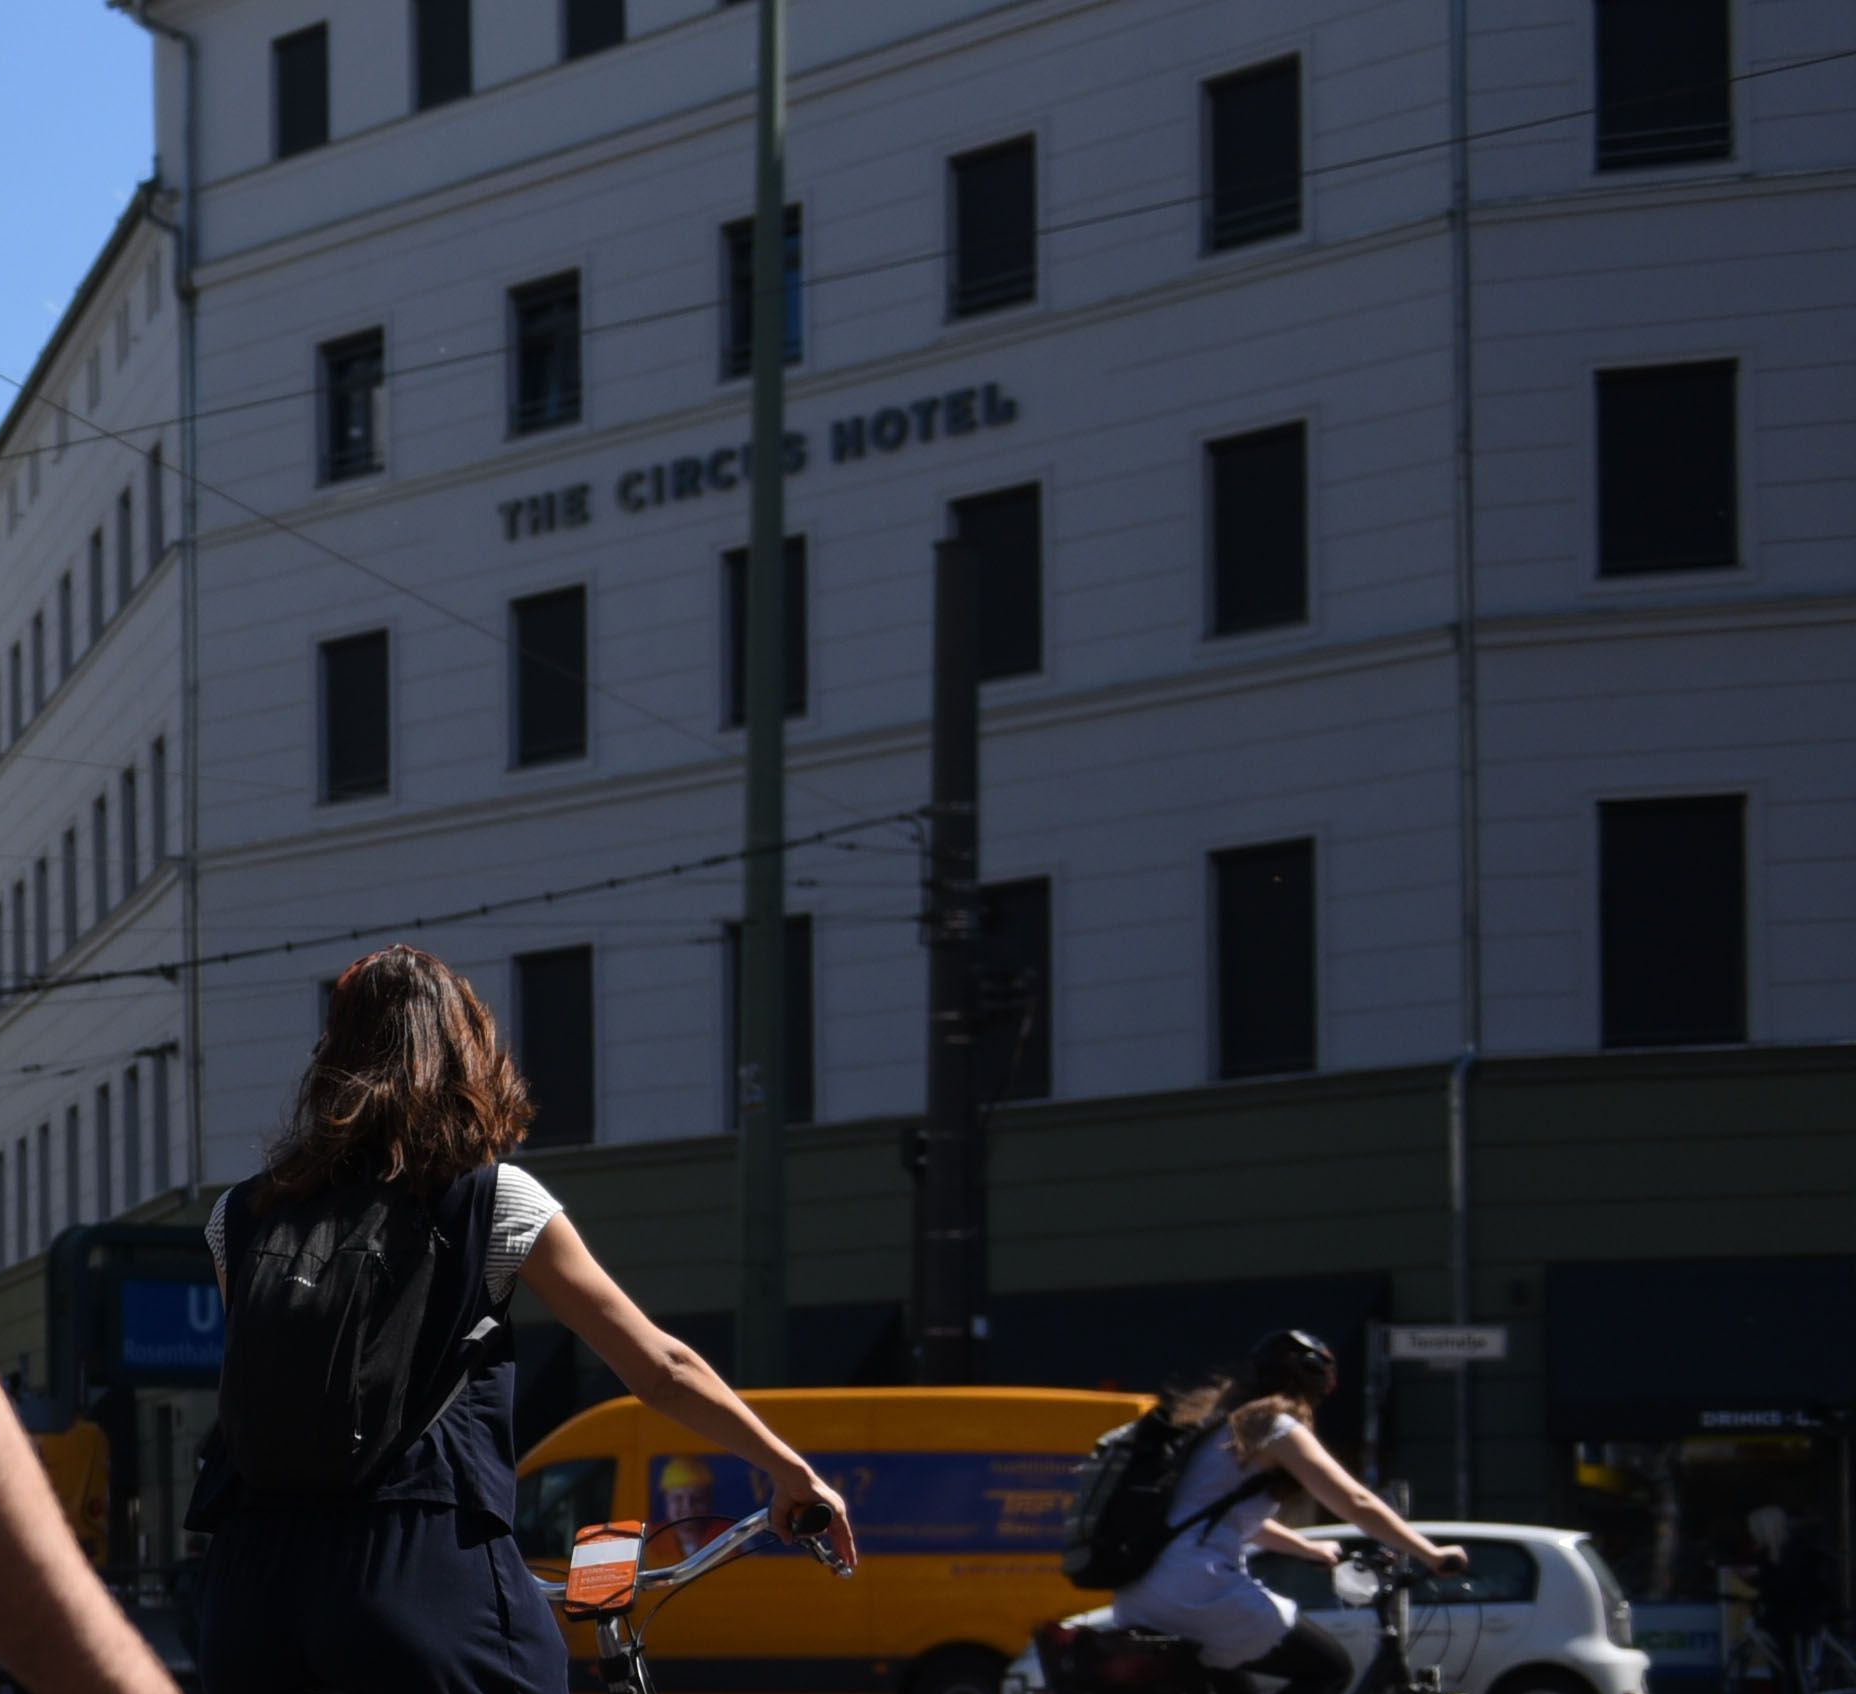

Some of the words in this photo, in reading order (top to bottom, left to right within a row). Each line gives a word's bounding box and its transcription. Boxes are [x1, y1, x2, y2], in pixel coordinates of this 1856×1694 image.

[498, 483, 592, 541] THE
[831, 382, 1019, 464] HOTEL
[188, 1286, 218, 1332] U
[123, 1338, 224, 1361] Rosenthale
[1699, 1408, 1783, 1427] DRINKS
